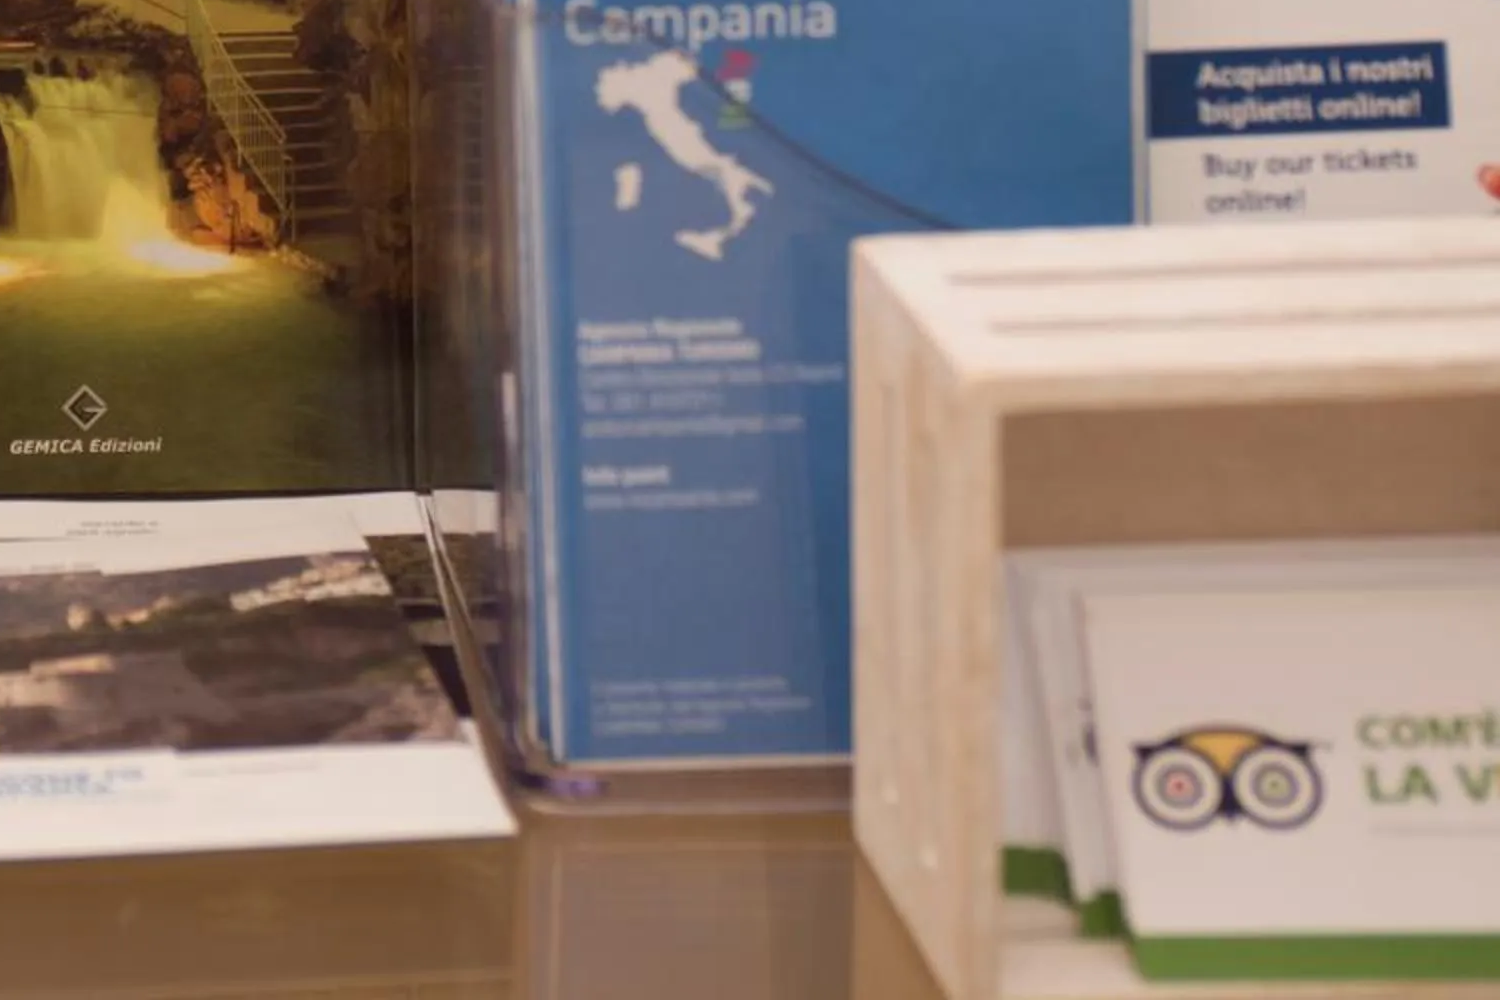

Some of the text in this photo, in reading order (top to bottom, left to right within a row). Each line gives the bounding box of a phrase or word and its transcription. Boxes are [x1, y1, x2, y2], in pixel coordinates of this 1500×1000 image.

[1197, 60, 1325, 91] Acquista
[1345, 54, 1434, 82] nostri
[1198, 88, 1422, 130] biglietti online!
[1203, 149, 1419, 180] Buy our tickets
[9, 436, 164, 455] GEMICA Edizioni
[1364, 762, 1440, 806] LA
